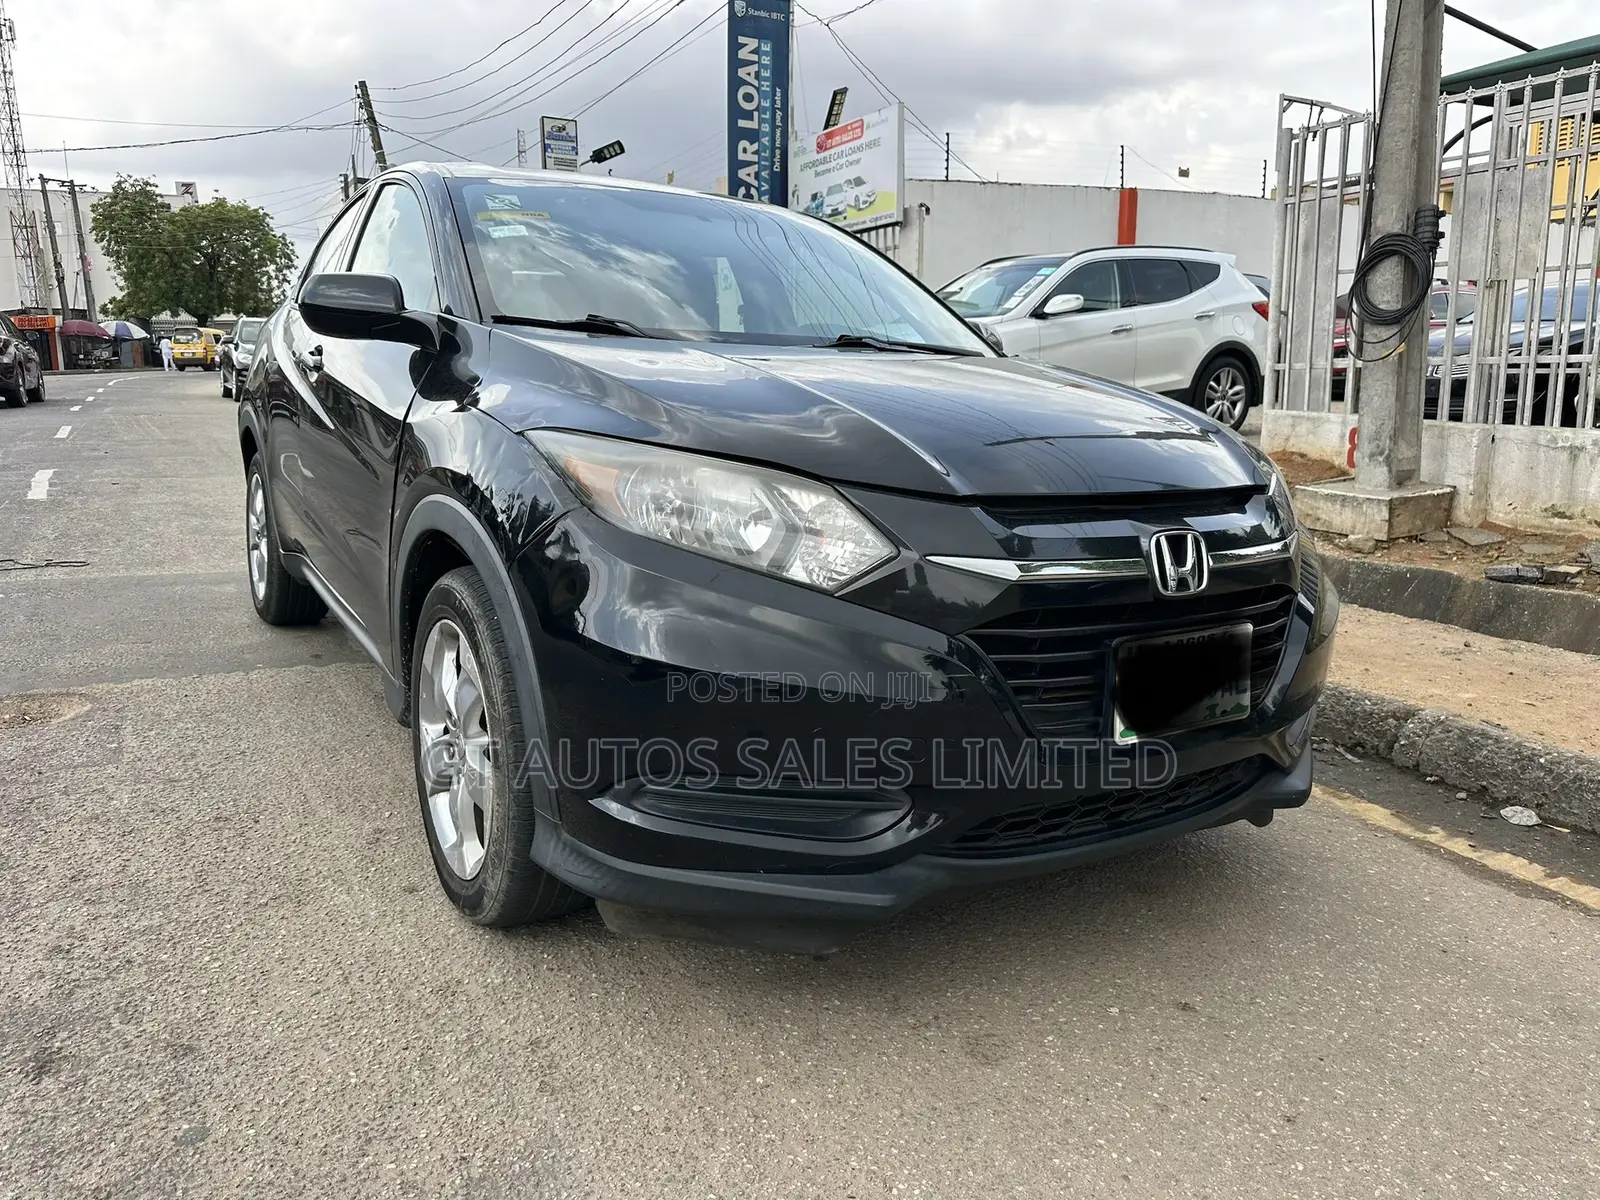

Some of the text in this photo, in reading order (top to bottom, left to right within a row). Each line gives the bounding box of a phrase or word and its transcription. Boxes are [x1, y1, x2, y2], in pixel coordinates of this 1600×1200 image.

[747, 7, 786, 21] Stanbic IBTC
[774, 87, 782, 108] later
[737, 35, 759, 201] CAR LOAN
[760, 42, 770, 204] AVAILABLE HERE
[775, 110, 783, 126] pay
[773, 148, 781, 171] Drive
[800, 138, 881, 172] AFFORDABLE CAR LOANS HERE
[814, 167, 832, 178] Become
[835, 161, 845, 172] Car
[844, 157, 862, 168] Owner
